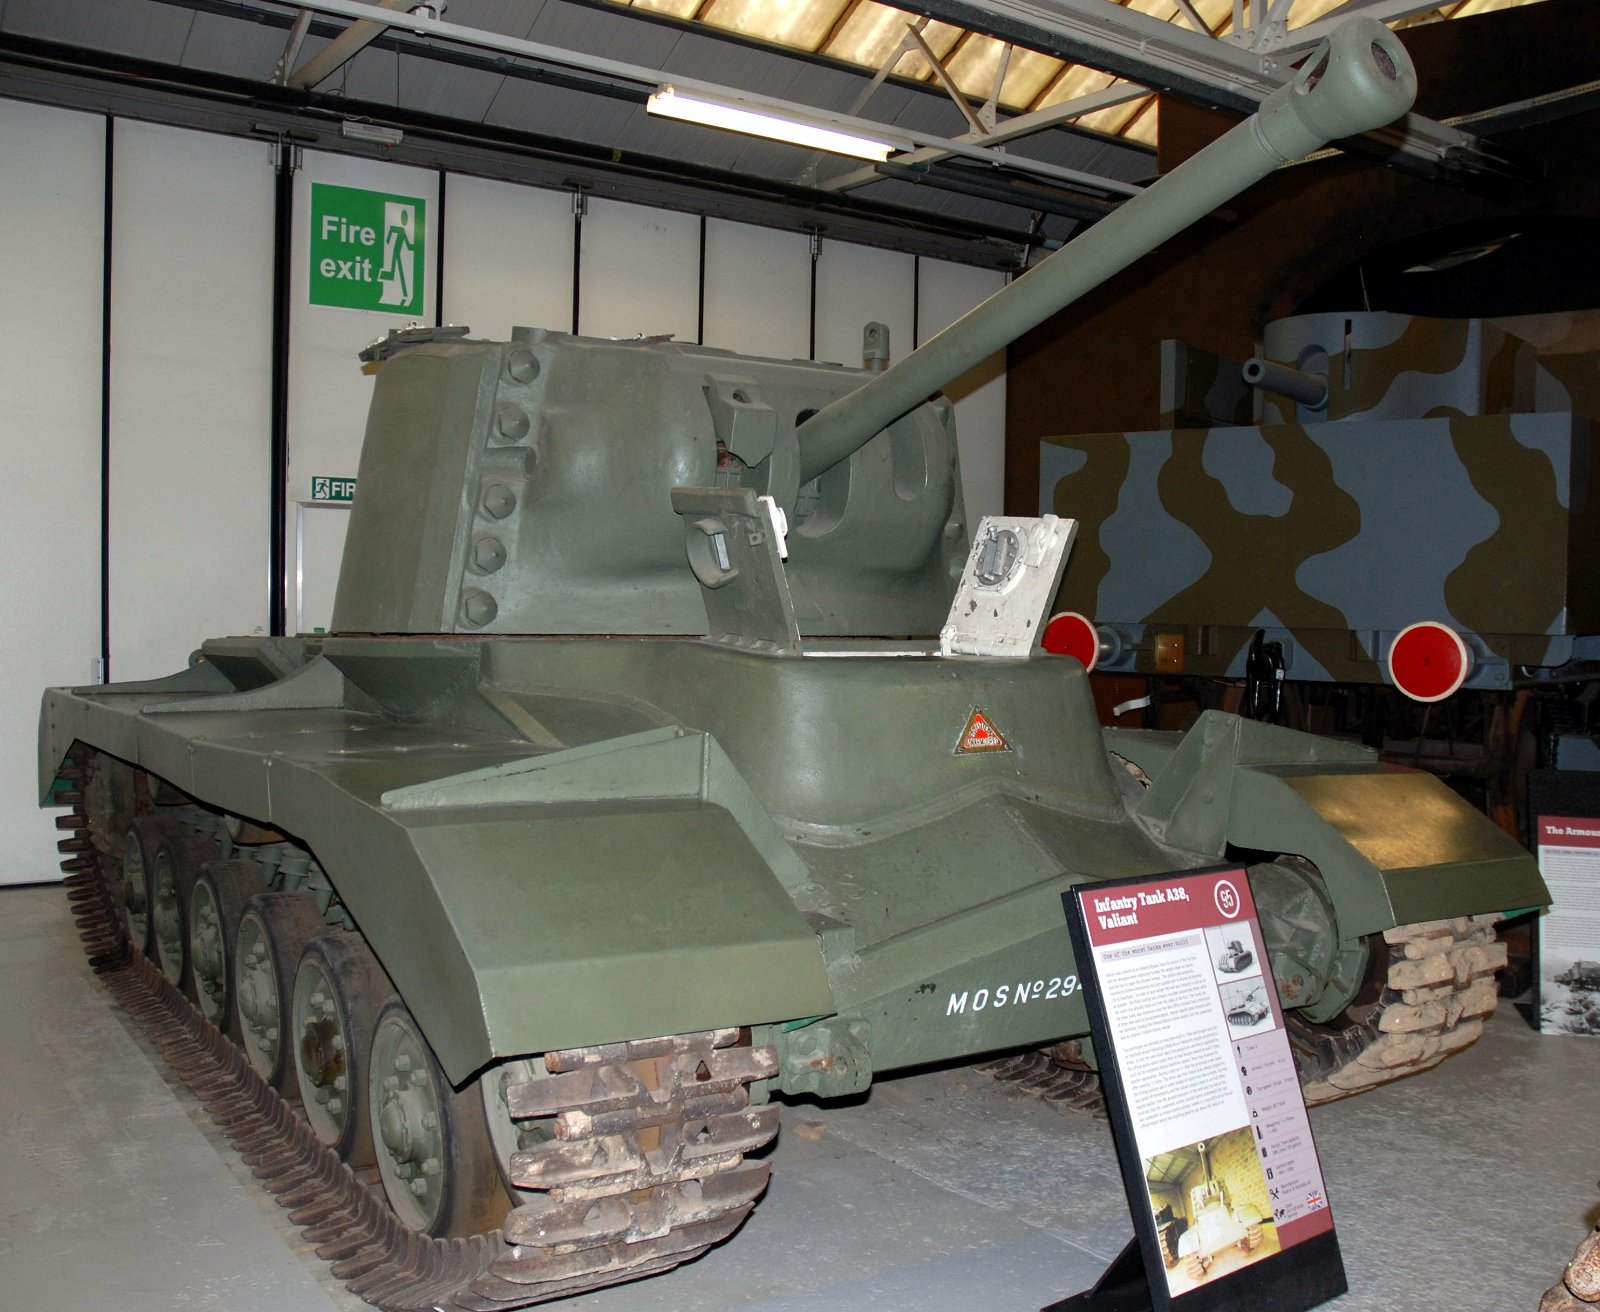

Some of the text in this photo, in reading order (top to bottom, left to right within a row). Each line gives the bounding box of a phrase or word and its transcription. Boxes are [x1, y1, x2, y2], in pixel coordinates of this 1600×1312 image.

[321, 215, 376, 246] Fire
[320, 257, 372, 282] exit
[1545, 826, 1564, 834] The
[1094, 887, 1189, 913] Infantry Tank A38,
[1220, 889, 1234, 909] 95
[1098, 912, 1138, 930] Valiant
